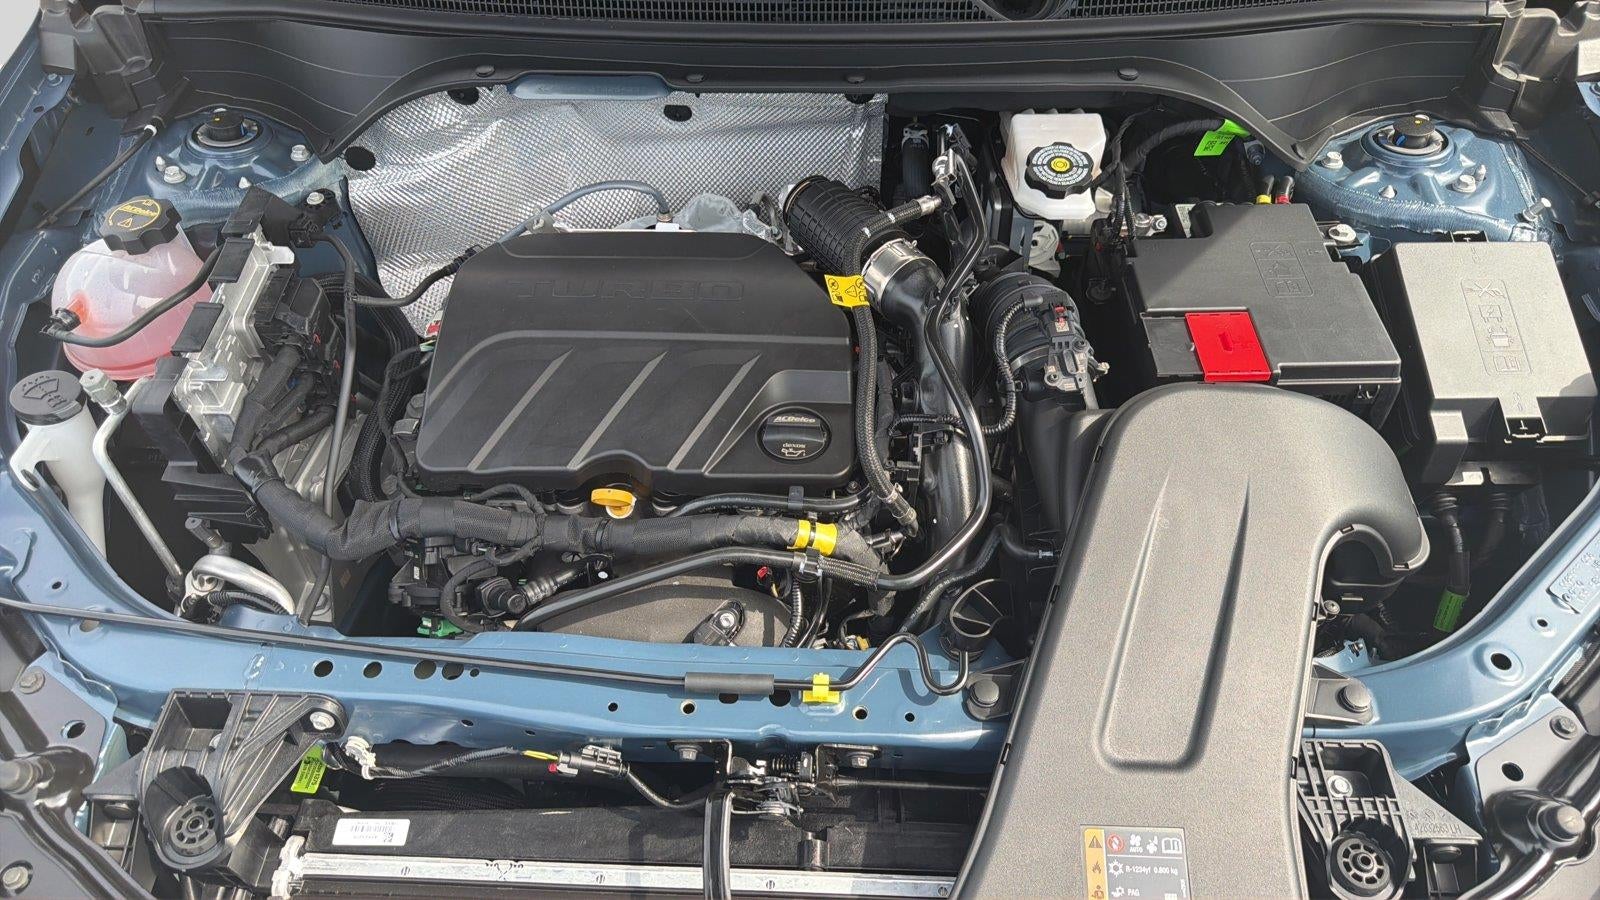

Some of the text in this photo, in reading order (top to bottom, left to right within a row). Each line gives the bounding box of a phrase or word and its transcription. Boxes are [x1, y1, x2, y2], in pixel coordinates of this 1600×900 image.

[508, 279, 744, 301] TURBO
[773, 415, 816, 423] ACDelco
[1171, 867, 1179, 875] kg
[1127, 888, 1141, 897] PAG
